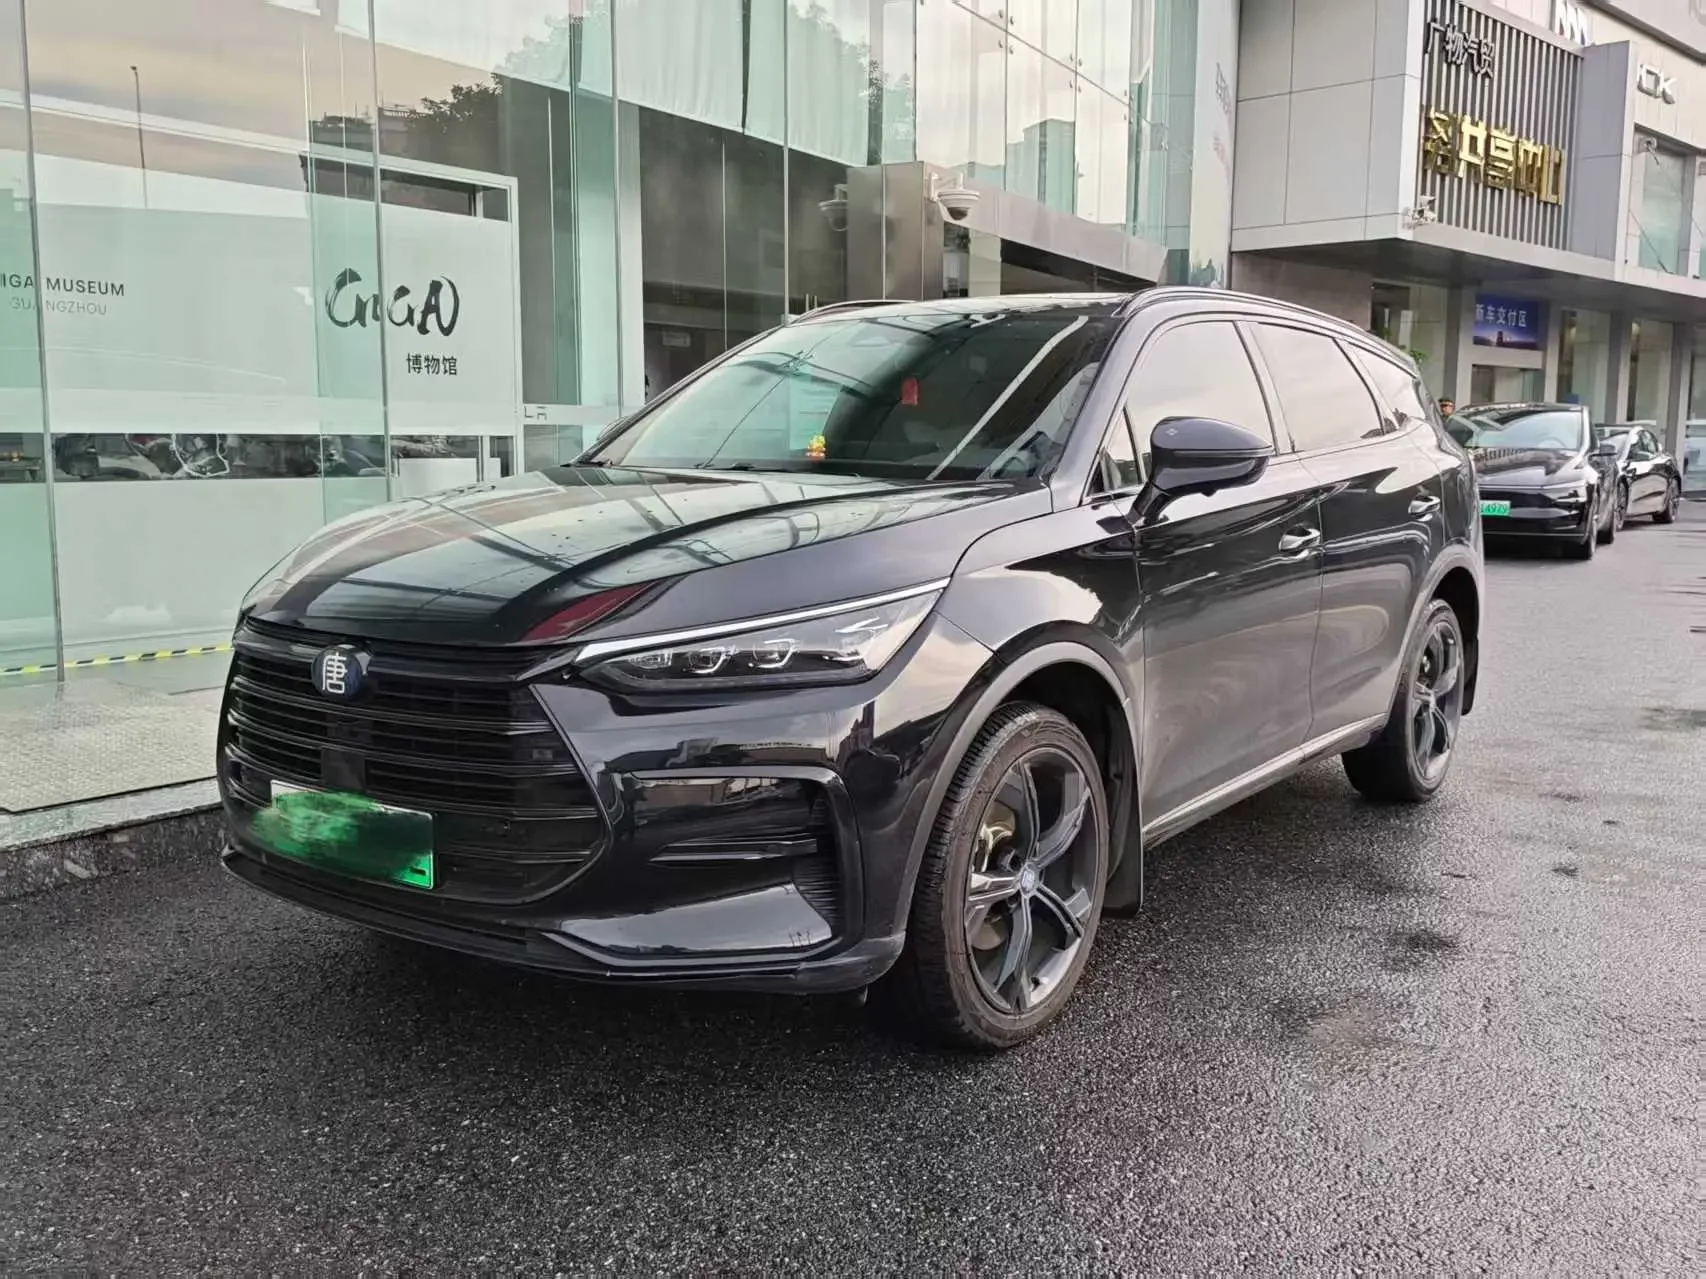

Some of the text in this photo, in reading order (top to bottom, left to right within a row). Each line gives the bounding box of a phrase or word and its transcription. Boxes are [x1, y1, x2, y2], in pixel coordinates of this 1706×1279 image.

[0, 272, 125, 297] IGA MUSEUM
[9, 296, 108, 316] GUNGZHOU
[405, 352, 458, 376] 博物馆
